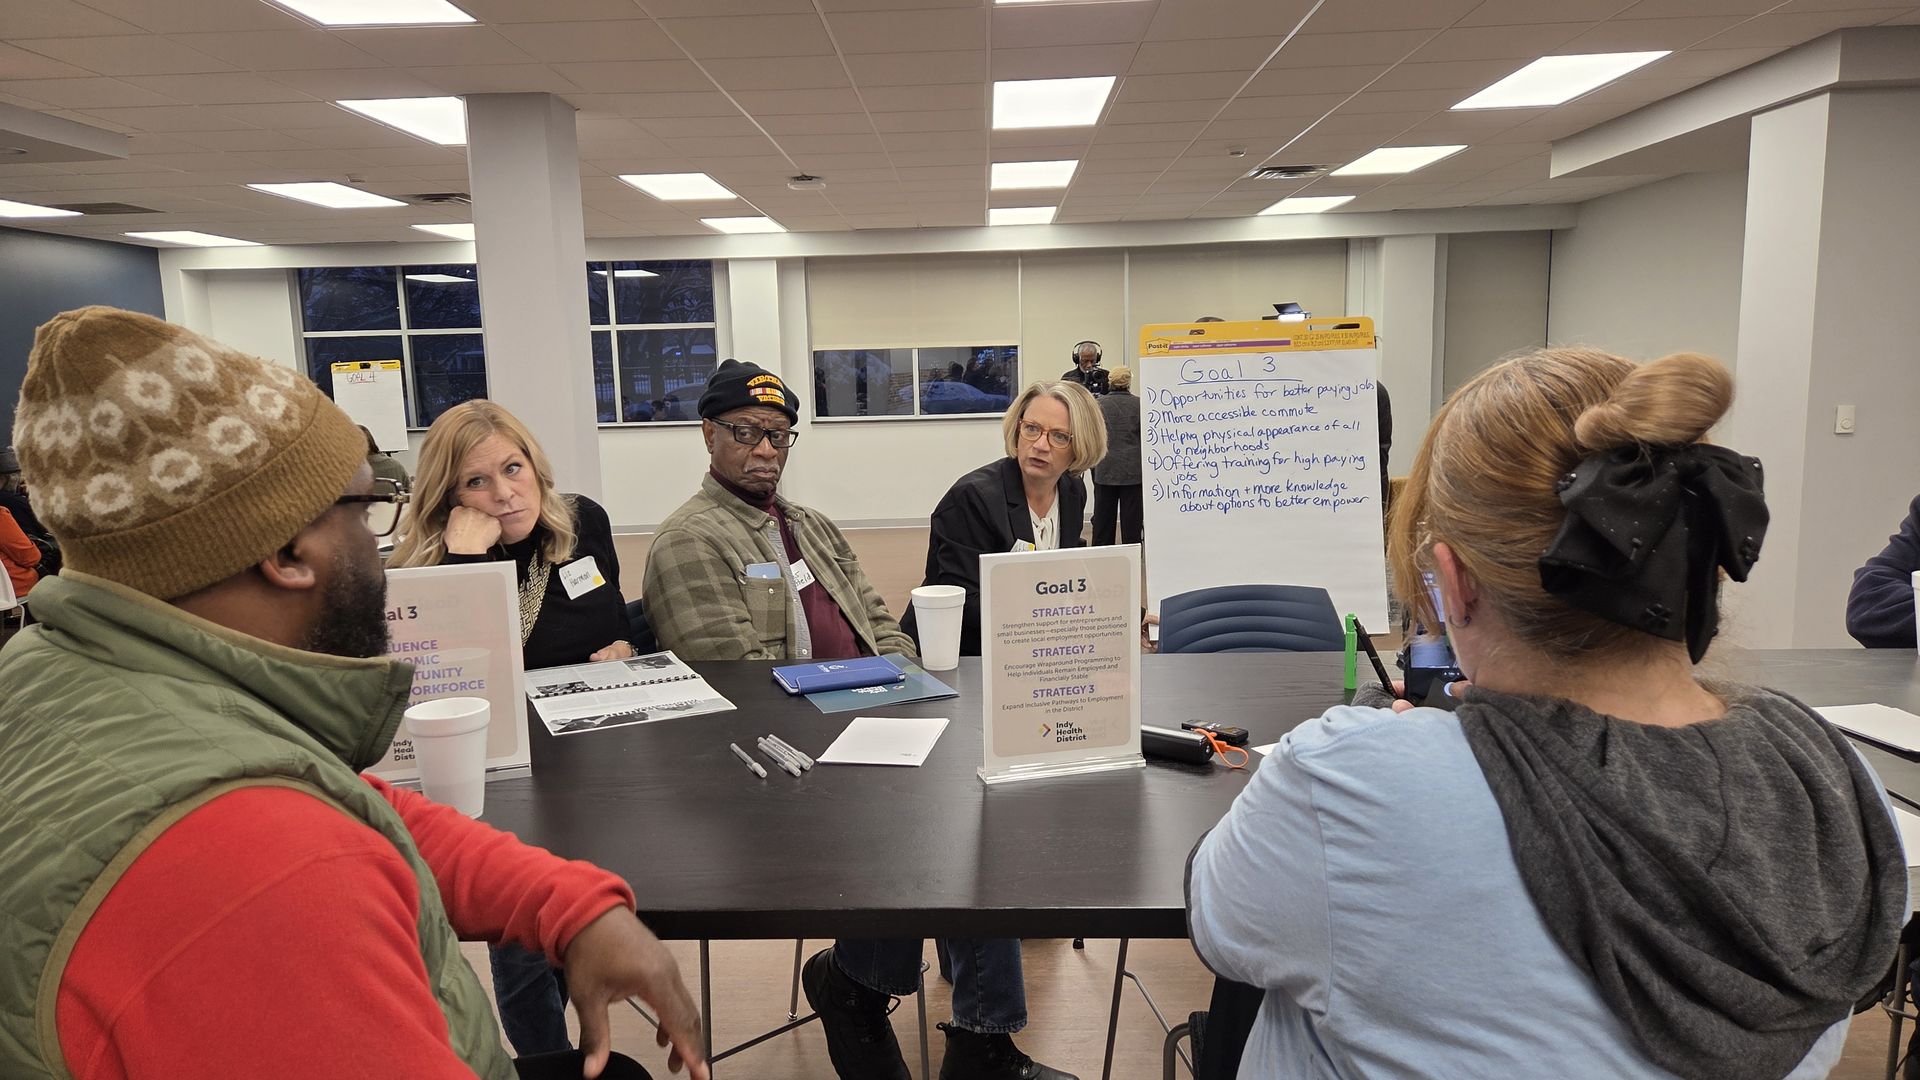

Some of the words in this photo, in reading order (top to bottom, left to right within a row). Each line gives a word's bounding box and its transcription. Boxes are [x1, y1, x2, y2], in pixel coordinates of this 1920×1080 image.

[1181, 359, 1242, 382] Goal
[1263, 356, 1276, 372] 3
[1147, 387, 1157, 404] 1)
[1160, 386, 1247, 410] Opportunities
[1254, 383, 1277, 399] for
[1283, 384, 1313, 397] better
[1317, 384, 1351, 400] paying
[1352, 379, 1375, 395] jobs
[1148, 409, 1161, 428] 2)
[1162, 410, 1195, 424] More
[1197, 405, 1257, 422] accessible
[1261, 402, 1318, 417] commute
[1147, 426, 1158, 446] 3)
[1203, 426, 1254, 445] physical
[1257, 424, 1320, 440] appearance
[1324, 420, 1340, 431] of
[1343, 420, 1360, 430] all
[1186, 439, 1270, 460] neighborhoods
[1148, 449, 1162, 470] 4)
[1163, 455, 1219, 478] Offering
[1222, 453, 1271, 475] training
[1272, 451, 1290, 464] for
[1294, 451, 1320, 470] high
[1324, 454, 1365, 470] paying
[1171, 471, 1197, 486] jobs
[1152, 478, 1164, 502] 5)
[1167, 484, 1240, 499] Information
[1253, 484, 1282, 495] more
[1286, 478, 1348, 496] knowledge
[1180, 500, 1215, 512] about
[1217, 497, 1254, 514] options
[1258, 494, 1270, 507] to
[1276, 495, 1311, 507] better
[1313, 496, 1370, 512] empower
[1035, 579, 1074, 595] Goal
[1077, 578, 1087, 592] 3
[386, 607, 403, 621] al
[407, 606, 418, 619] 3
[1032, 605, 1086, 618] STRATEGY
[1089, 605, 1095, 614] 1
[997, 630, 1013, 638] small
[1097, 622, 1127, 631] positioned
[1002, 620, 1035, 629] Strengthen
[1036, 619, 1059, 628] support
[1069, 616, 1110, 625] entrepreneurs
[1046, 633, 1083, 642] employment
[1084, 630, 1123, 639] opportunities
[1032, 645, 1086, 658] STRATEGY
[1088, 644, 1095, 653] 2
[1004, 662, 1036, 670] Encourage
[1037, 659, 1073, 668] Wraparound
[1074, 656, 1113, 665] Programming
[1023, 668, 1054, 676] Individuals
[1055, 666, 1077, 674] Remain
[1078, 663, 1106, 672] Employed
[1040, 674, 1070, 682] Financially
[411, 680, 485, 695] ORKFORCE
[1033, 685, 1087, 698] STRATEGY
[1088, 684, 1095, 693] 3
[1002, 703, 1024, 711] Expand
[1025, 700, 1050, 708] Inclusive
[1051, 698, 1079, 706] Pathways
[1087, 694, 1124, 702] Employment
[1056, 721, 1073, 729] Indy
[1056, 727, 1083, 736] Health
[1056, 734, 1087, 743] District
[394, 746, 414, 754] Heal
